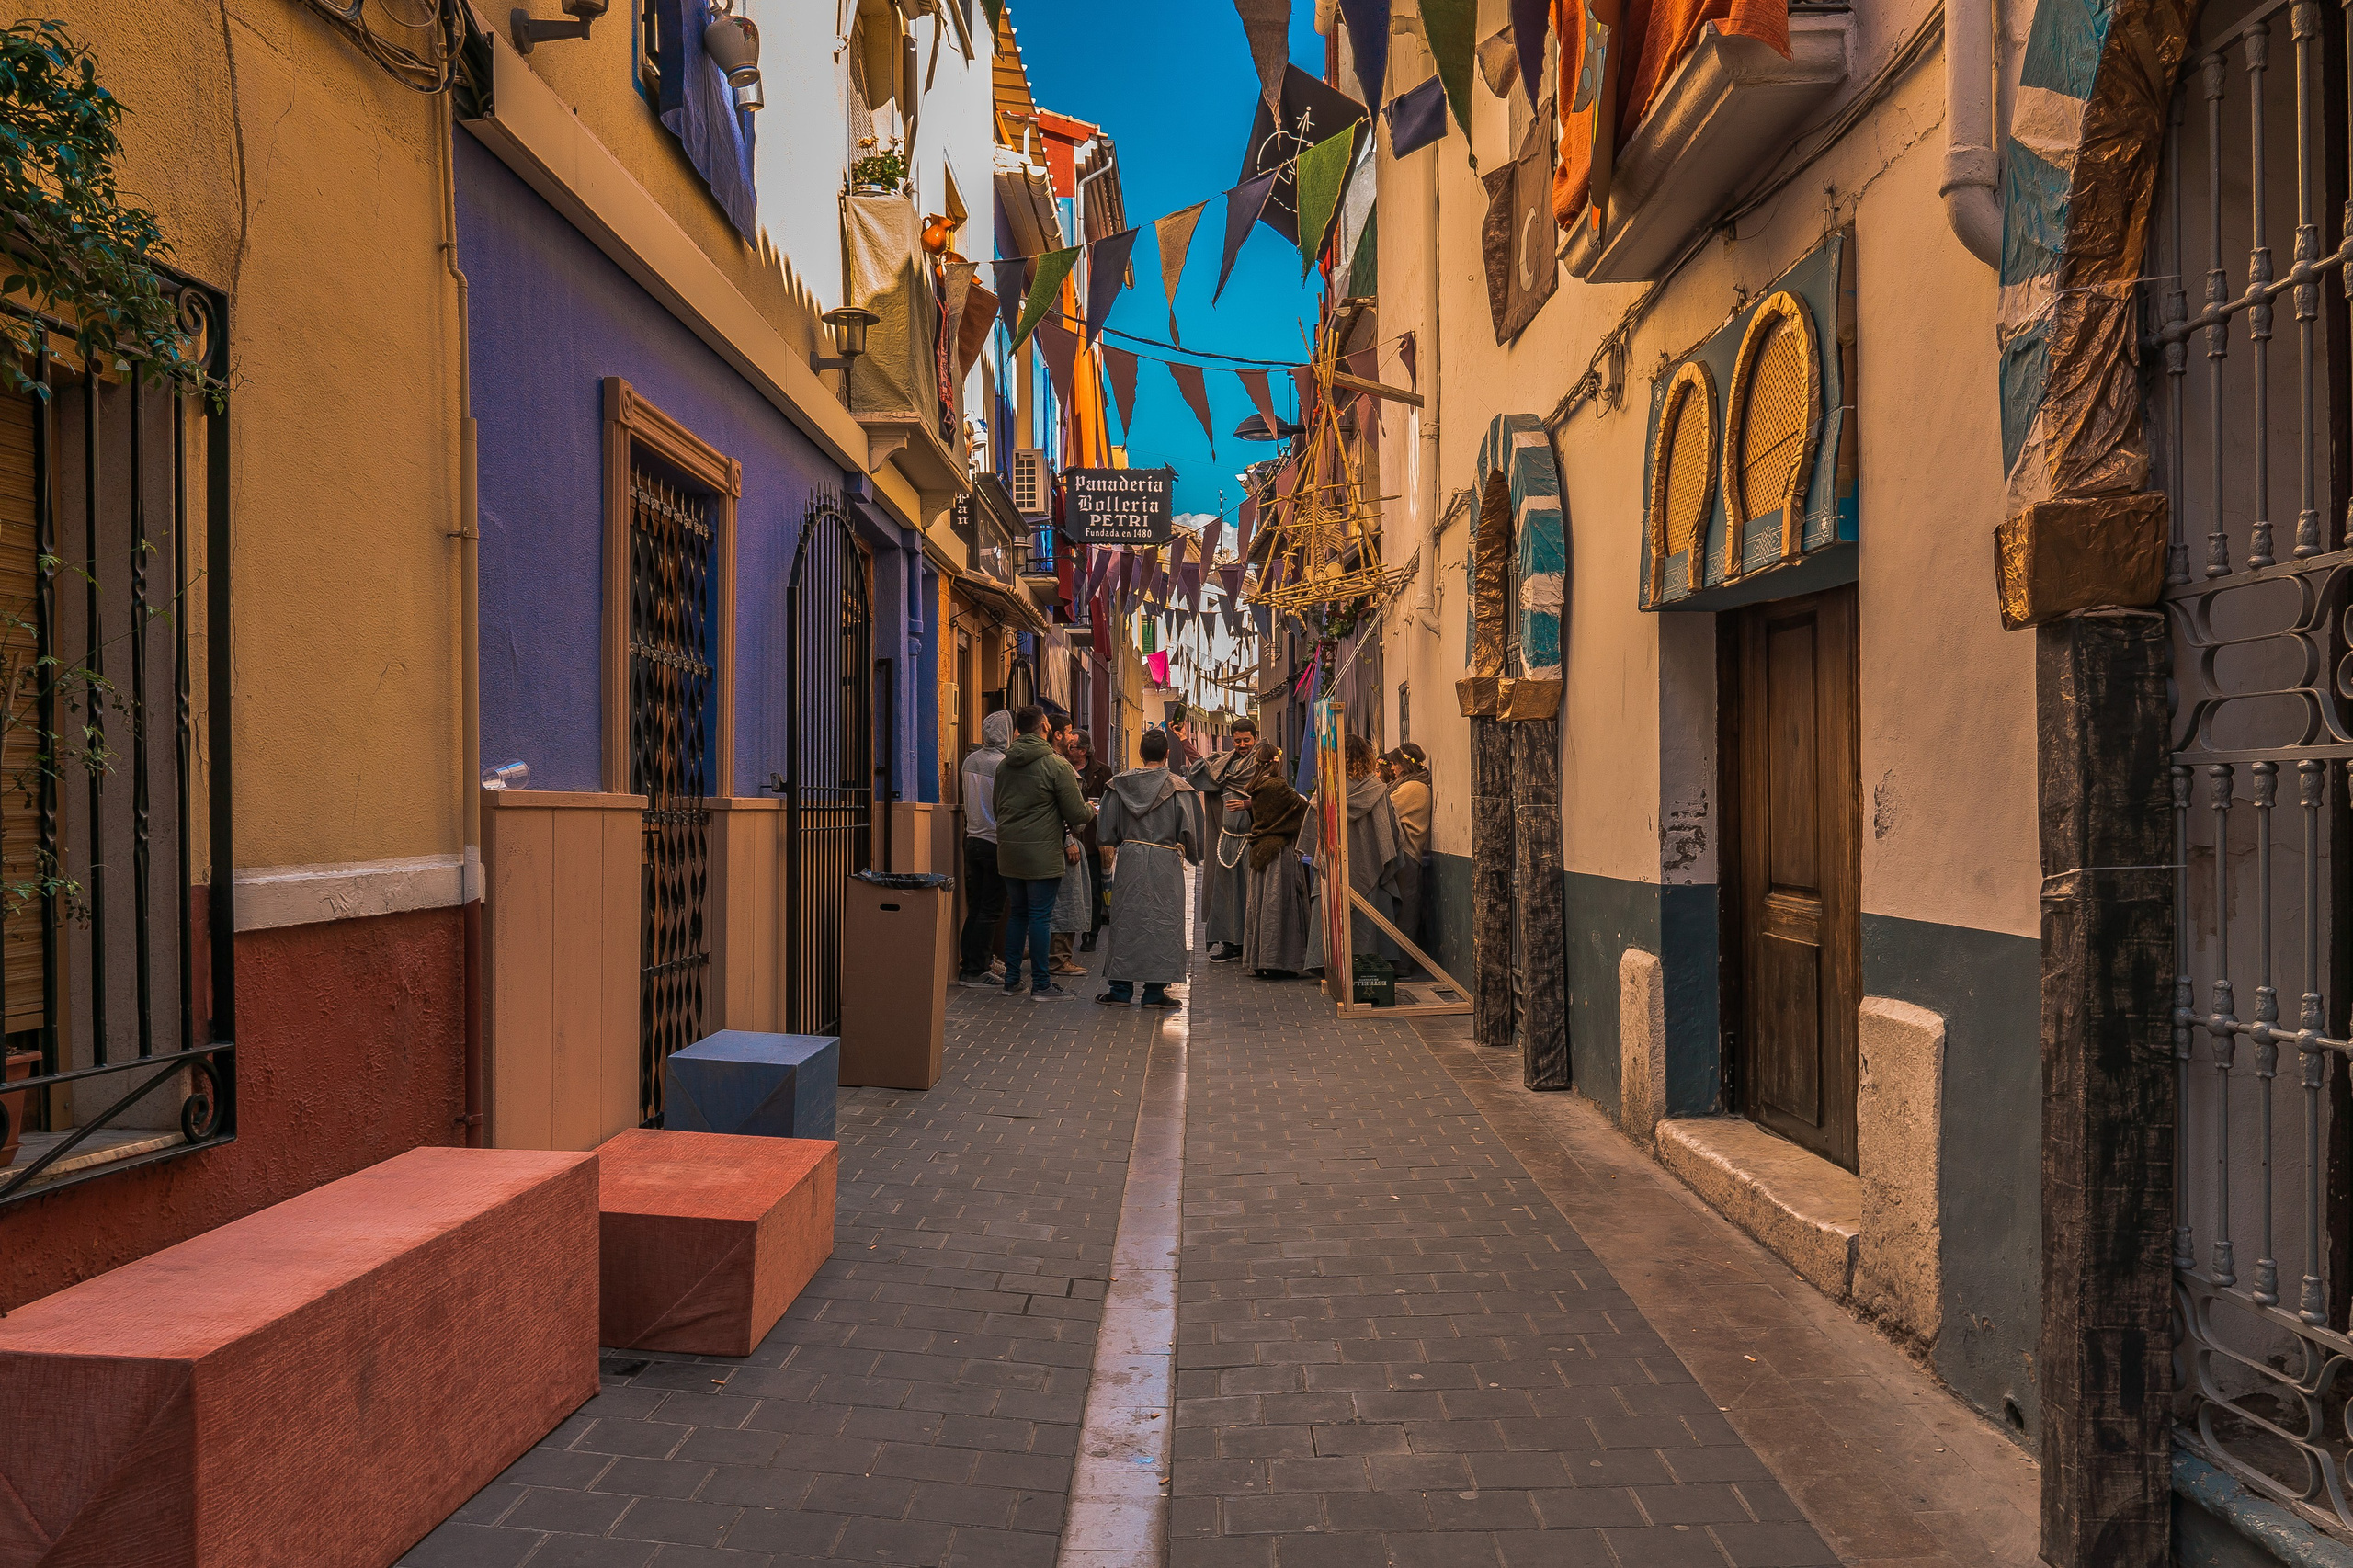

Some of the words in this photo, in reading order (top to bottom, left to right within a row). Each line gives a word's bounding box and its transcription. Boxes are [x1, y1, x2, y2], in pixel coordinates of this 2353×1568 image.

[1075, 475, 1164, 493] Panaderia
[1077, 494, 1159, 513] Bolleria
[1089, 514, 1149, 528] PETRI
[1086, 528, 1120, 538] Fundada
[1121, 529, 1131, 538] en
[1133, 528, 1153, 539] 1480
